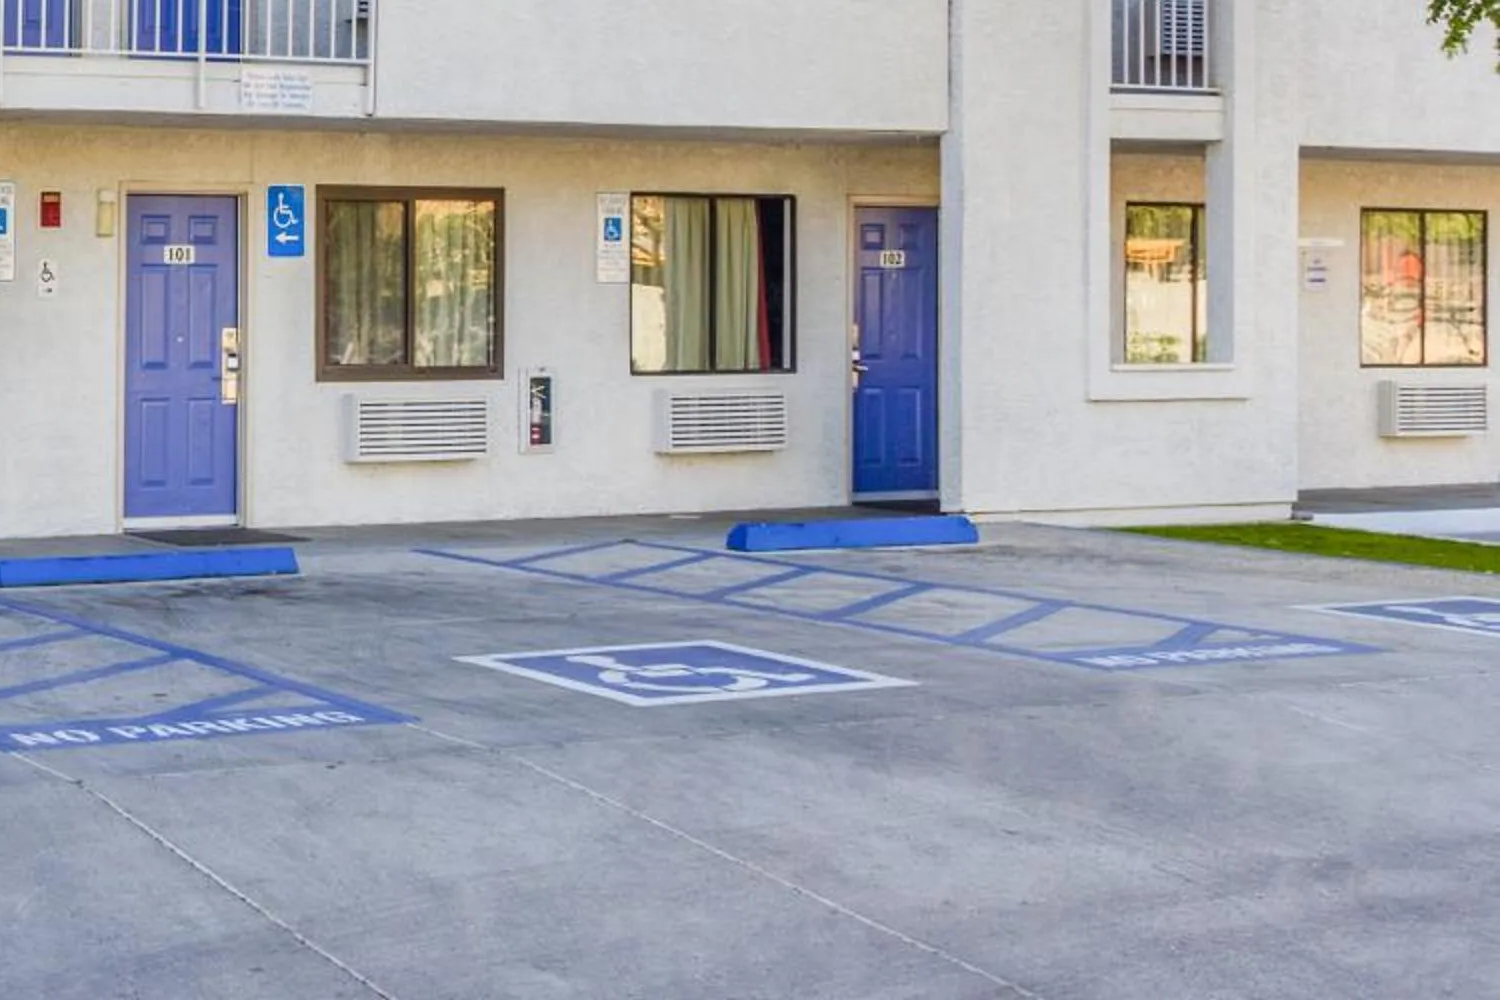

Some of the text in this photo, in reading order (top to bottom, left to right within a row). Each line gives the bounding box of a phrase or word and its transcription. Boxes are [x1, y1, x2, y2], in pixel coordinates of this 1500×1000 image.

[169, 247, 191, 261] 101
[883, 252, 902, 265] 102
[9, 710, 366, 746] NO PARKING
